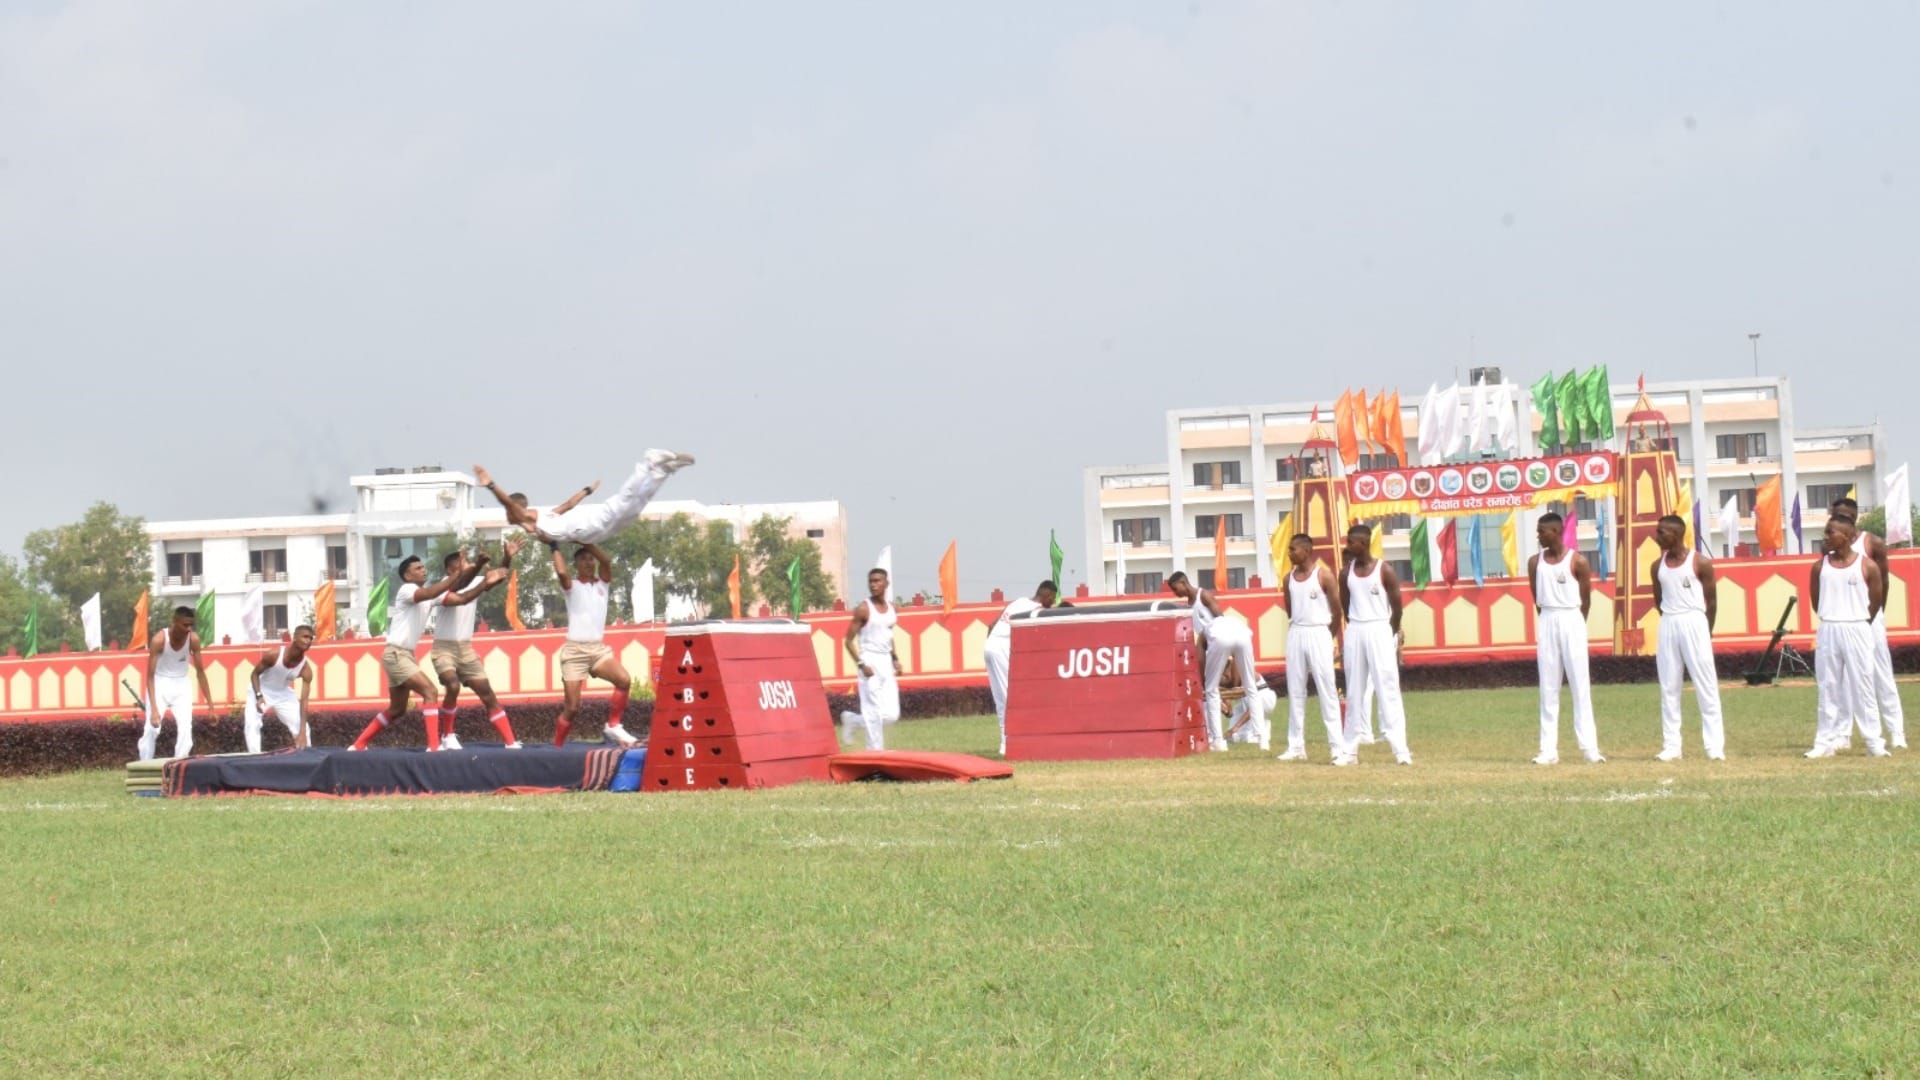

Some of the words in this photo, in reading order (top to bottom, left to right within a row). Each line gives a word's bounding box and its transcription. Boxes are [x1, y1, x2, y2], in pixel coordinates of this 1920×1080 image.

[682, 650, 693, 665] A
[1058, 646, 1130, 678] JOSH
[684, 688, 694, 703] B
[759, 680, 797, 710] JOSH
[682, 715, 692, 731] C
[684, 743, 695, 758] D
[686, 769, 695, 784] E
